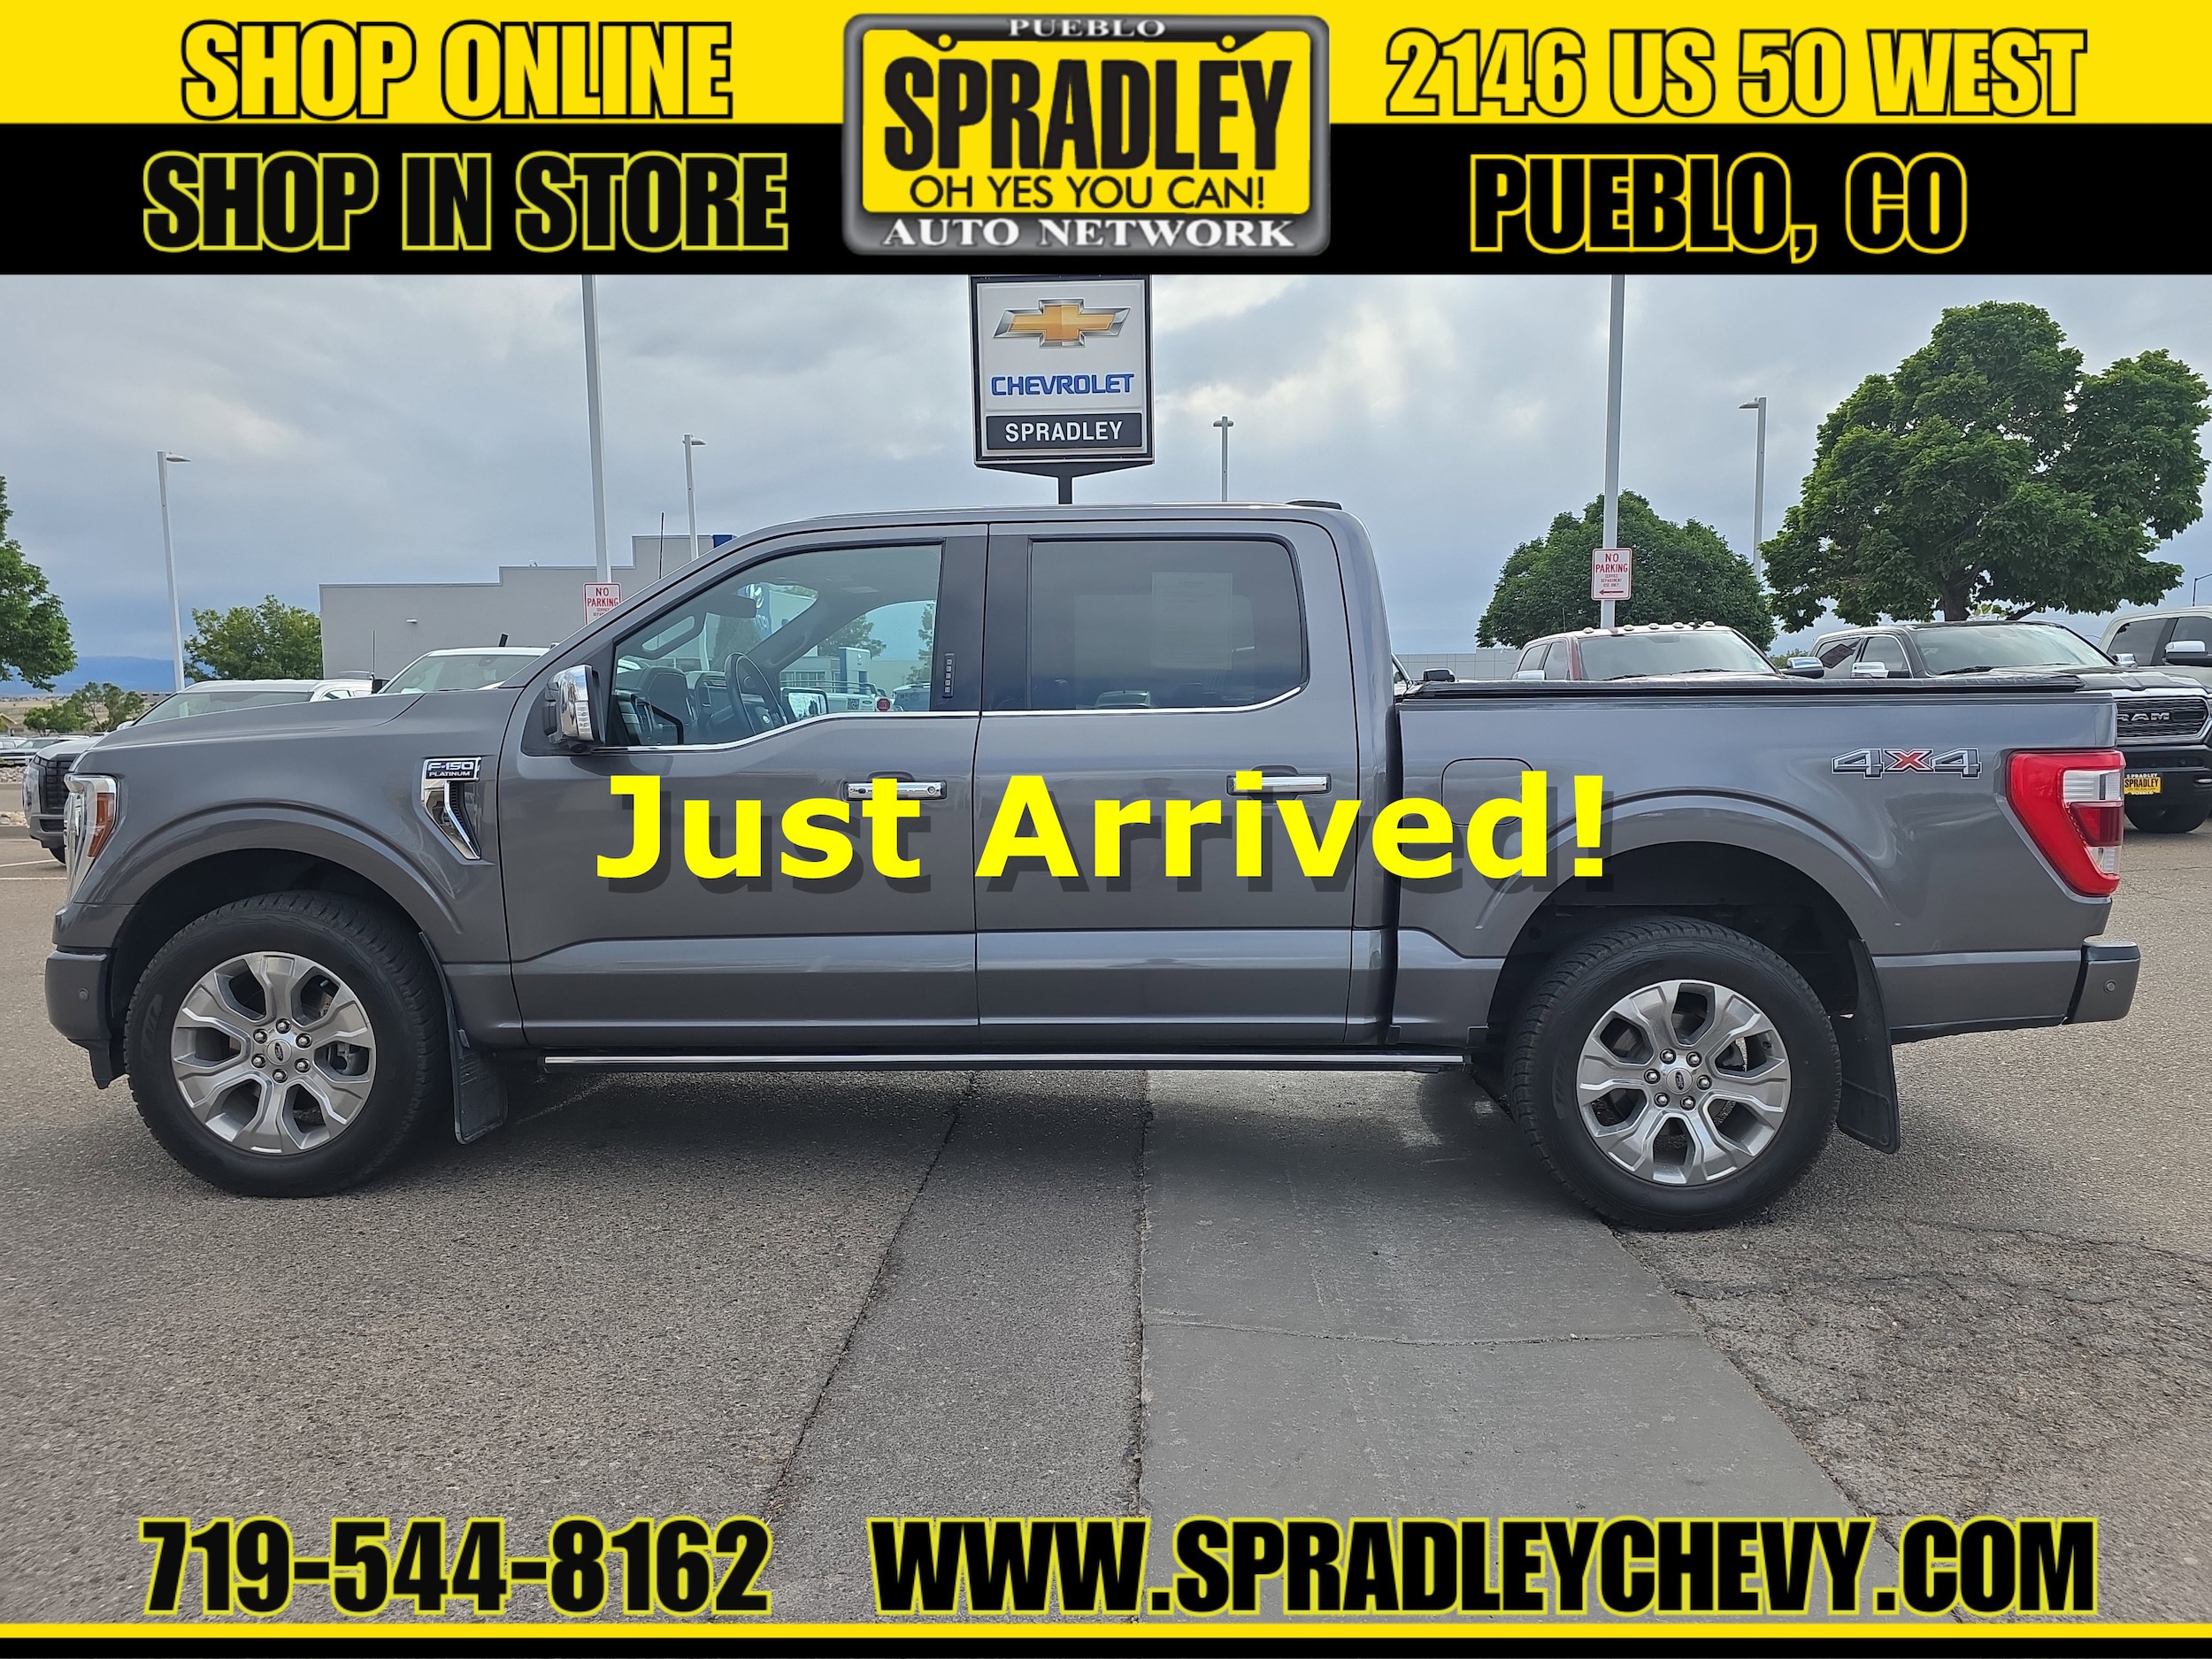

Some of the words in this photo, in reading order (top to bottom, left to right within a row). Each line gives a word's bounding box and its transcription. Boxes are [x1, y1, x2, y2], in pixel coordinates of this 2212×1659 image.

[991, 373, 1134, 396] CHEVROLET
[1005, 421, 1123, 442] SPRADLEY
[1605, 553, 1619, 563] NO
[1595, 564, 1628, 573] PARKING
[595, 588, 609, 596] NO
[587, 597, 618, 607] PARKING
[427, 761, 474, 771] F-150
[2124, 778, 2159, 787] SPRADLEY
